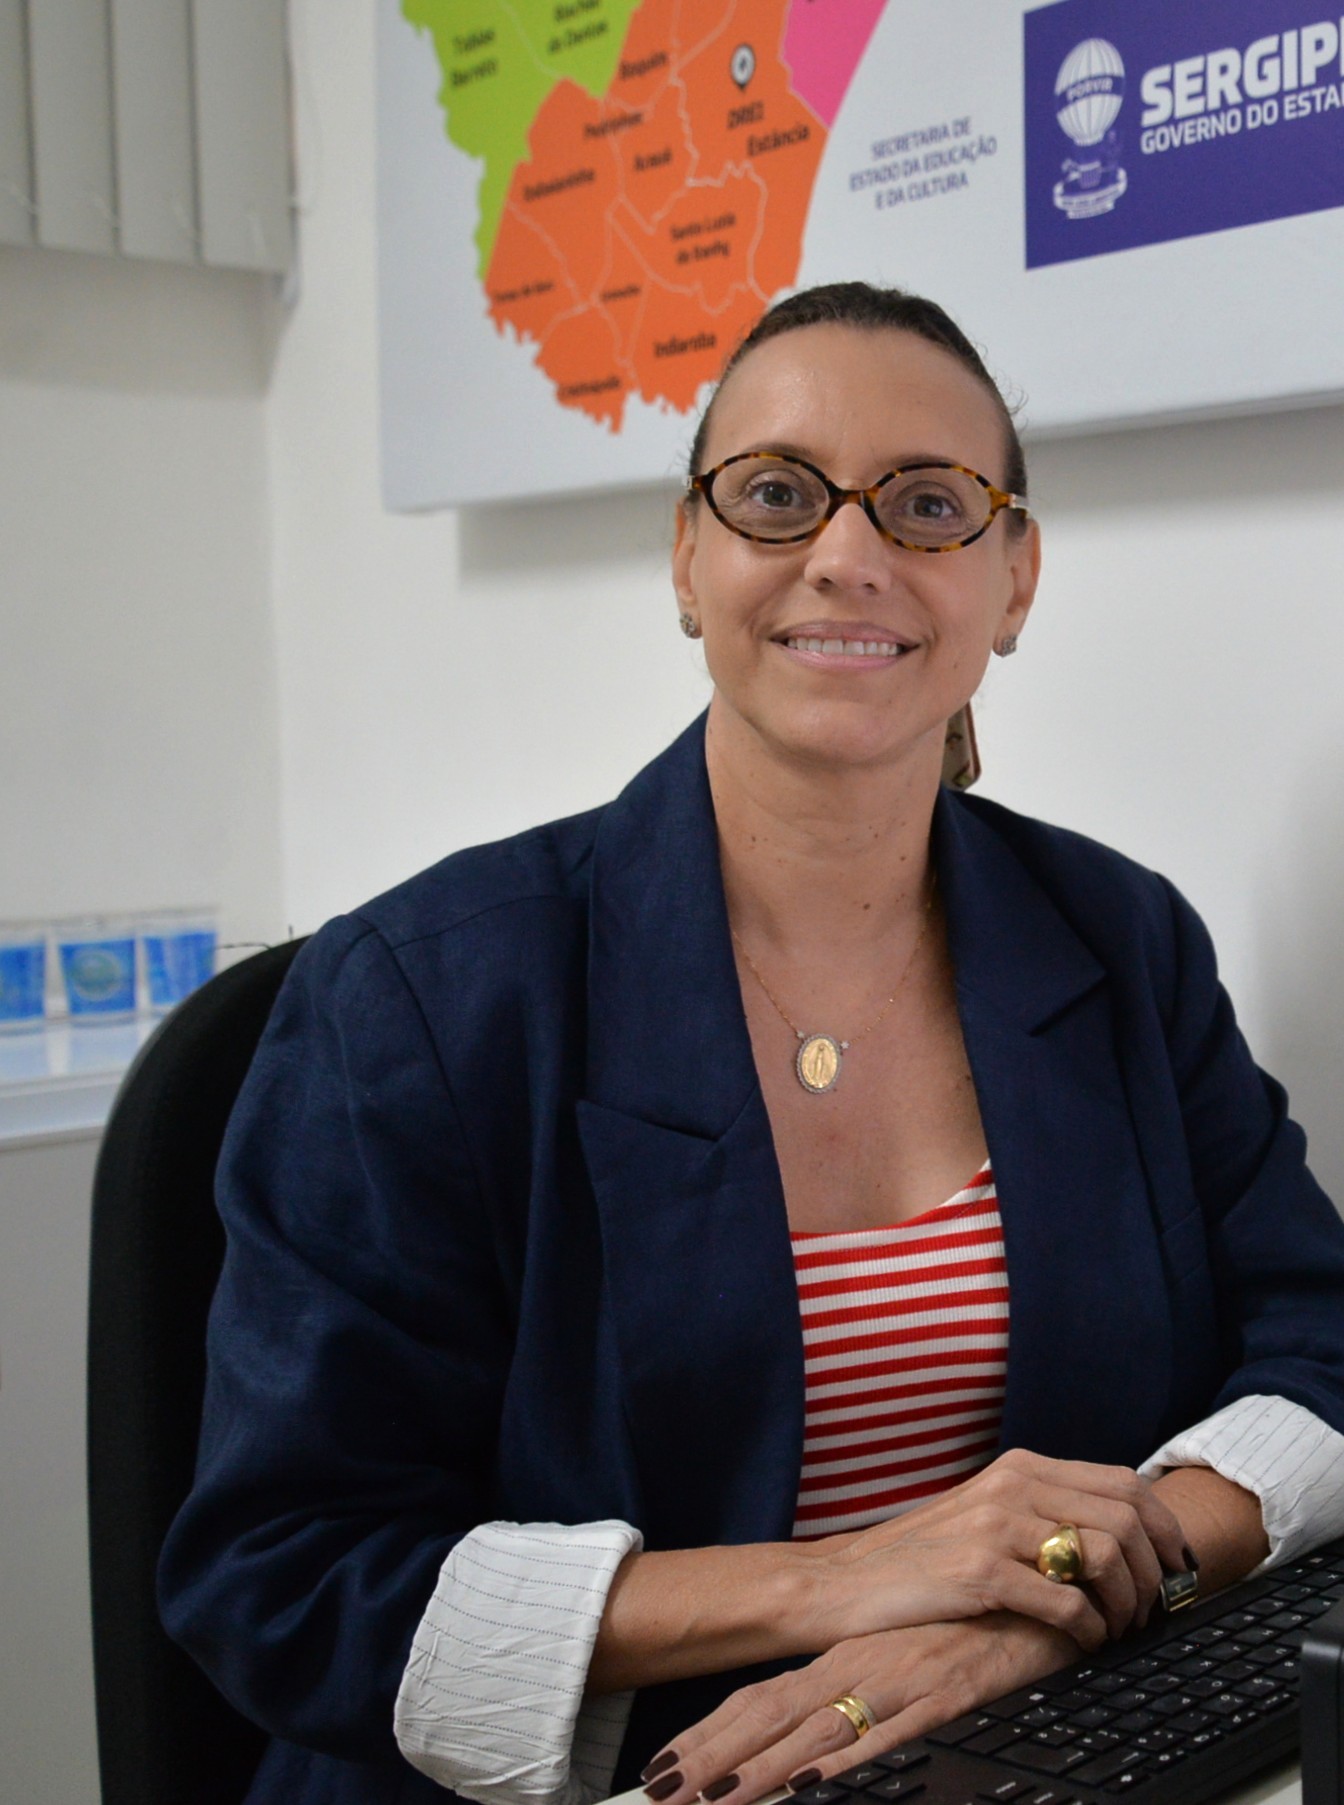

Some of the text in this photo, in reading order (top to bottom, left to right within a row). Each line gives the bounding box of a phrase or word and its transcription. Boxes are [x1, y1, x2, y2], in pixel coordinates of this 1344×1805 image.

[747, 122, 811, 156] Estância
[871, 115, 971, 160] SECRETARIA DE
[1140, 107, 1242, 154] GOVERNO
[1247, 99, 1279, 130] DO
[849, 134, 998, 191] ESTADO DA EDUCAÇÃO
[875, 172, 968, 210] E DA CULTURA
[654, 332, 717, 357] Indiaroba
